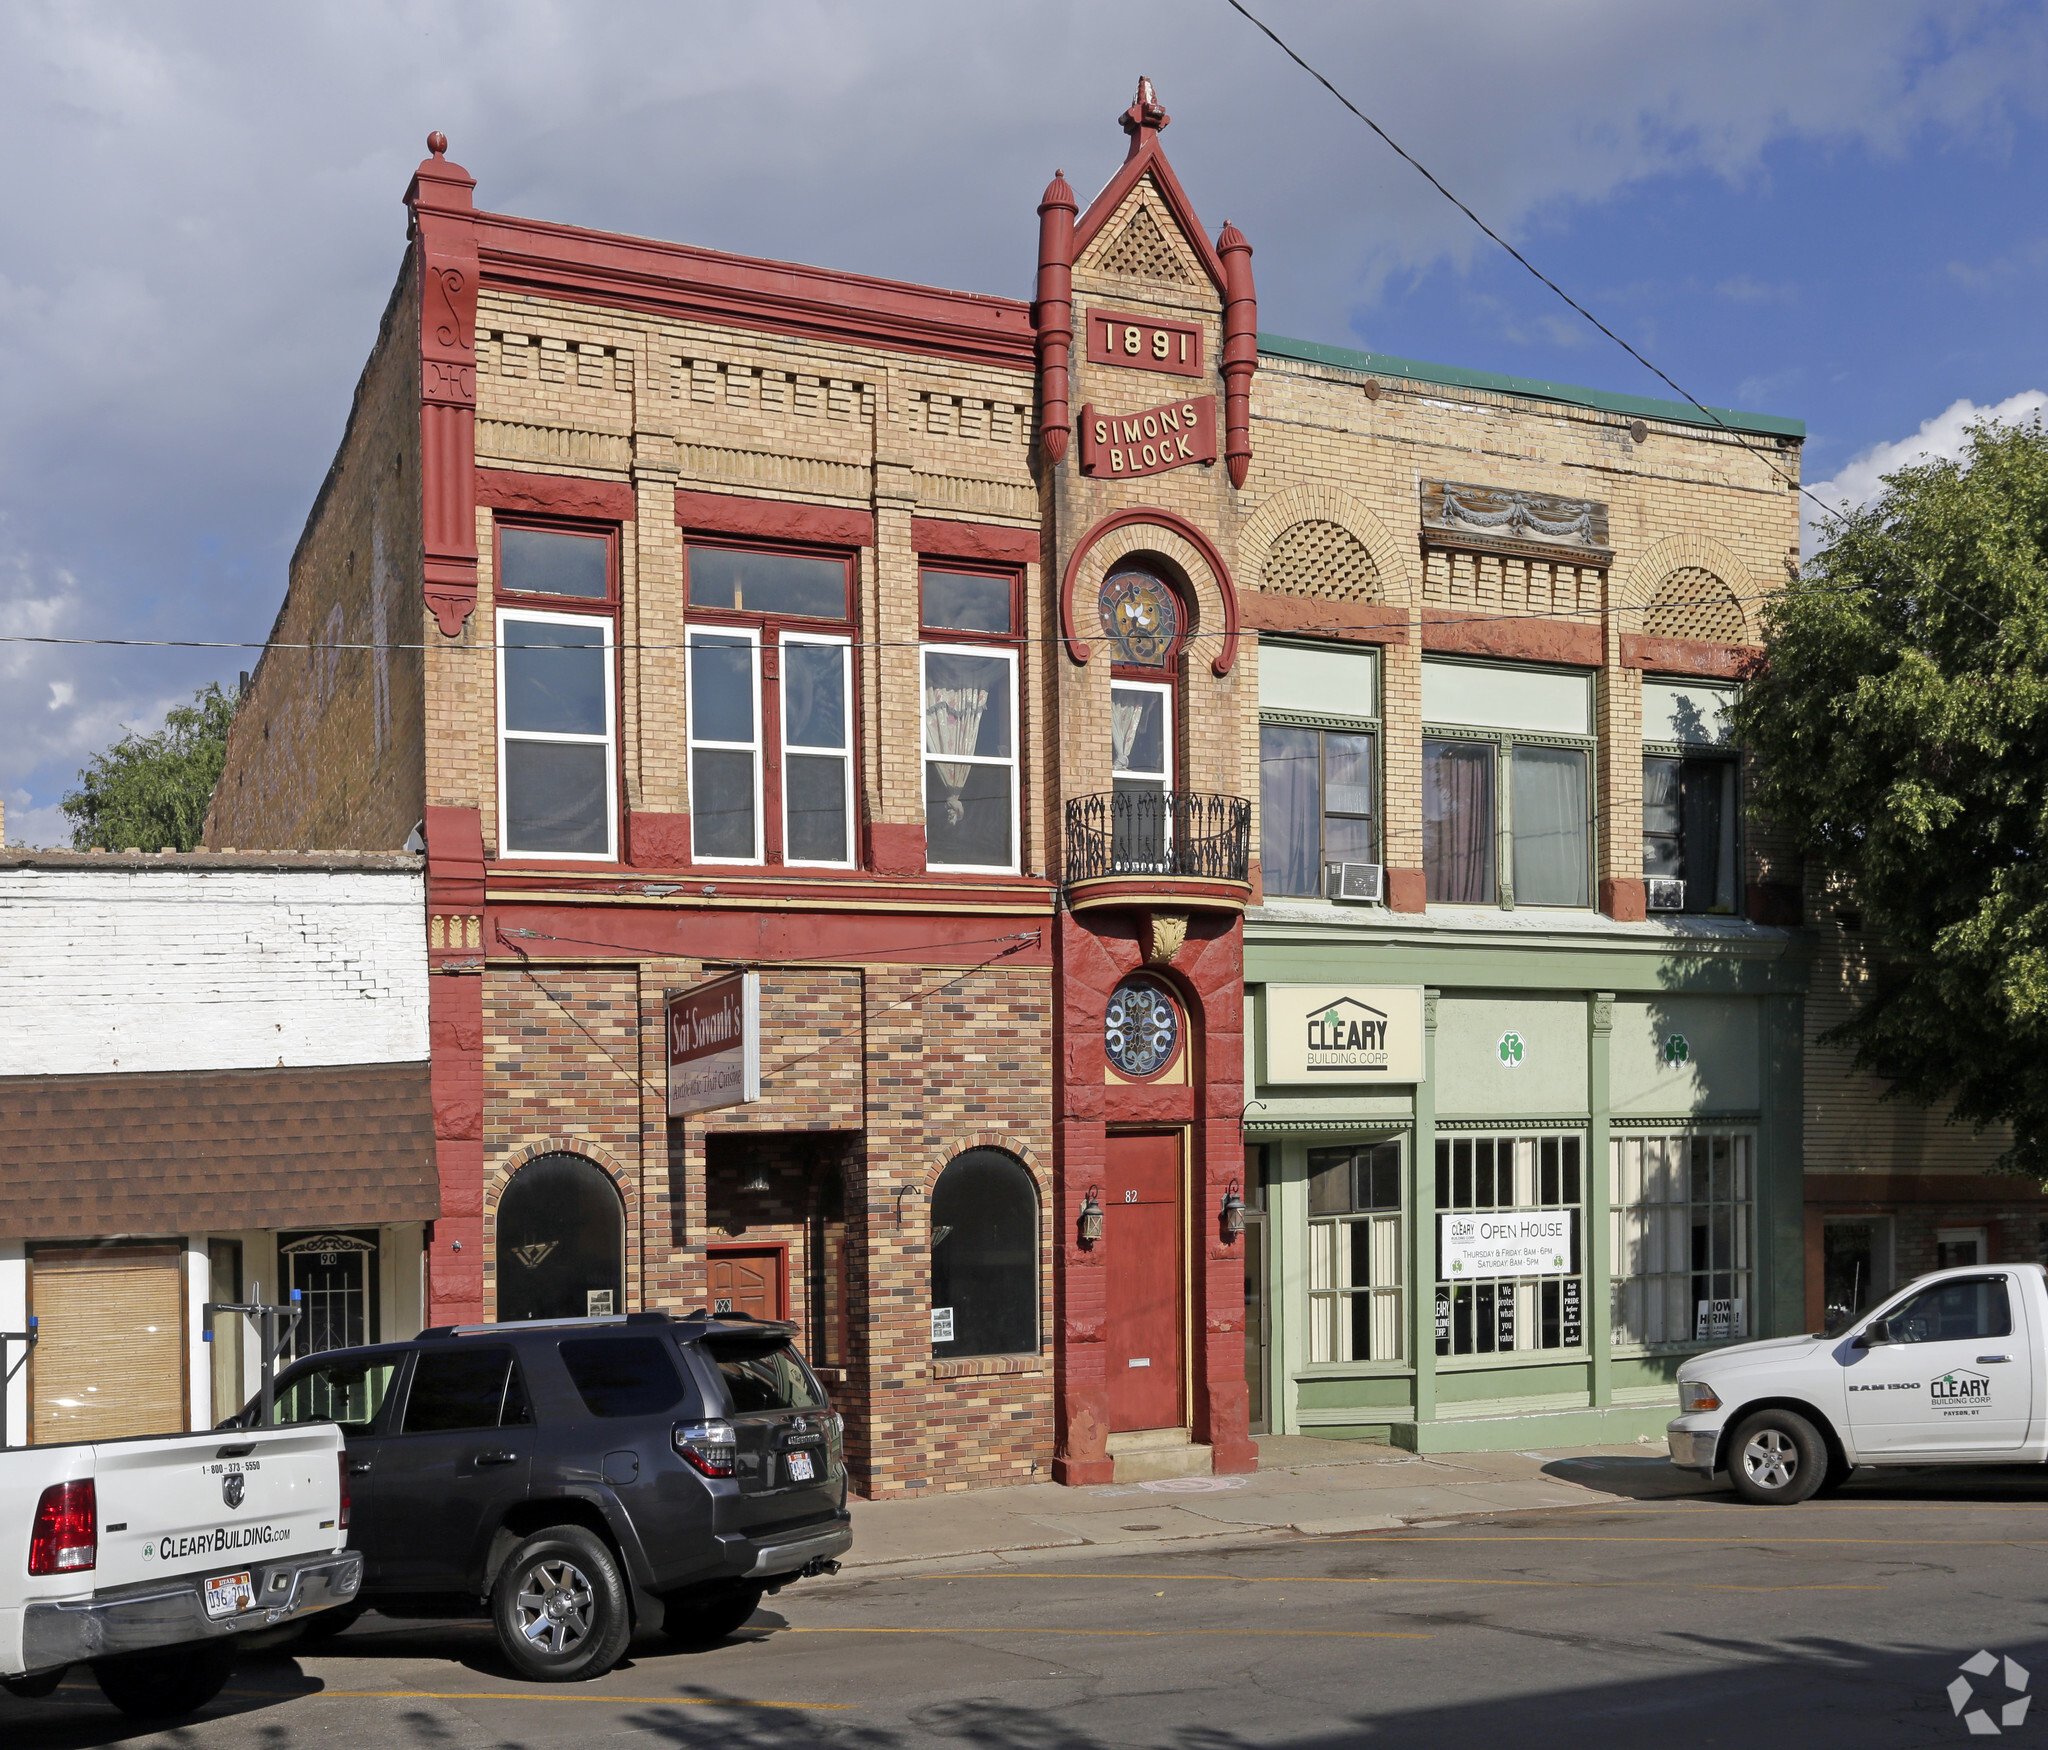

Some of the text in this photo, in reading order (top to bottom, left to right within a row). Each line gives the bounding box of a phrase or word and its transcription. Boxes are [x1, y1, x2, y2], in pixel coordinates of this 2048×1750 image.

[1107, 323, 1187, 361] 1891
[1095, 404, 1198, 443] SIMONS
[1110, 434, 1195, 472] BLOCK
[673, 993, 741, 1055] Sai Savanh's
[1307, 1020, 1388, 1051] CLEARY
[1307, 1052, 1389, 1064] BUILDING CORP.
[1125, 1190, 1138, 1203] 82
[1451, 1223, 1475, 1236] CLEARY
[321, 1254, 336, 1264] 90
[1502, 1286, 1512, 1295] We
[1564, 1297, 1580, 1305] PRIDE
[1500, 1308, 1514, 1318] what
[1566, 1305, 1579, 1313] before
[1501, 1322, 1512, 1332] you
[1565, 1334, 1580, 1343] applied
[1887, 1382, 1921, 1390] 1500
[1930, 1379, 1990, 1398] CLEARY
[1931, 1396, 1992, 1406] BUILDING CORP.
